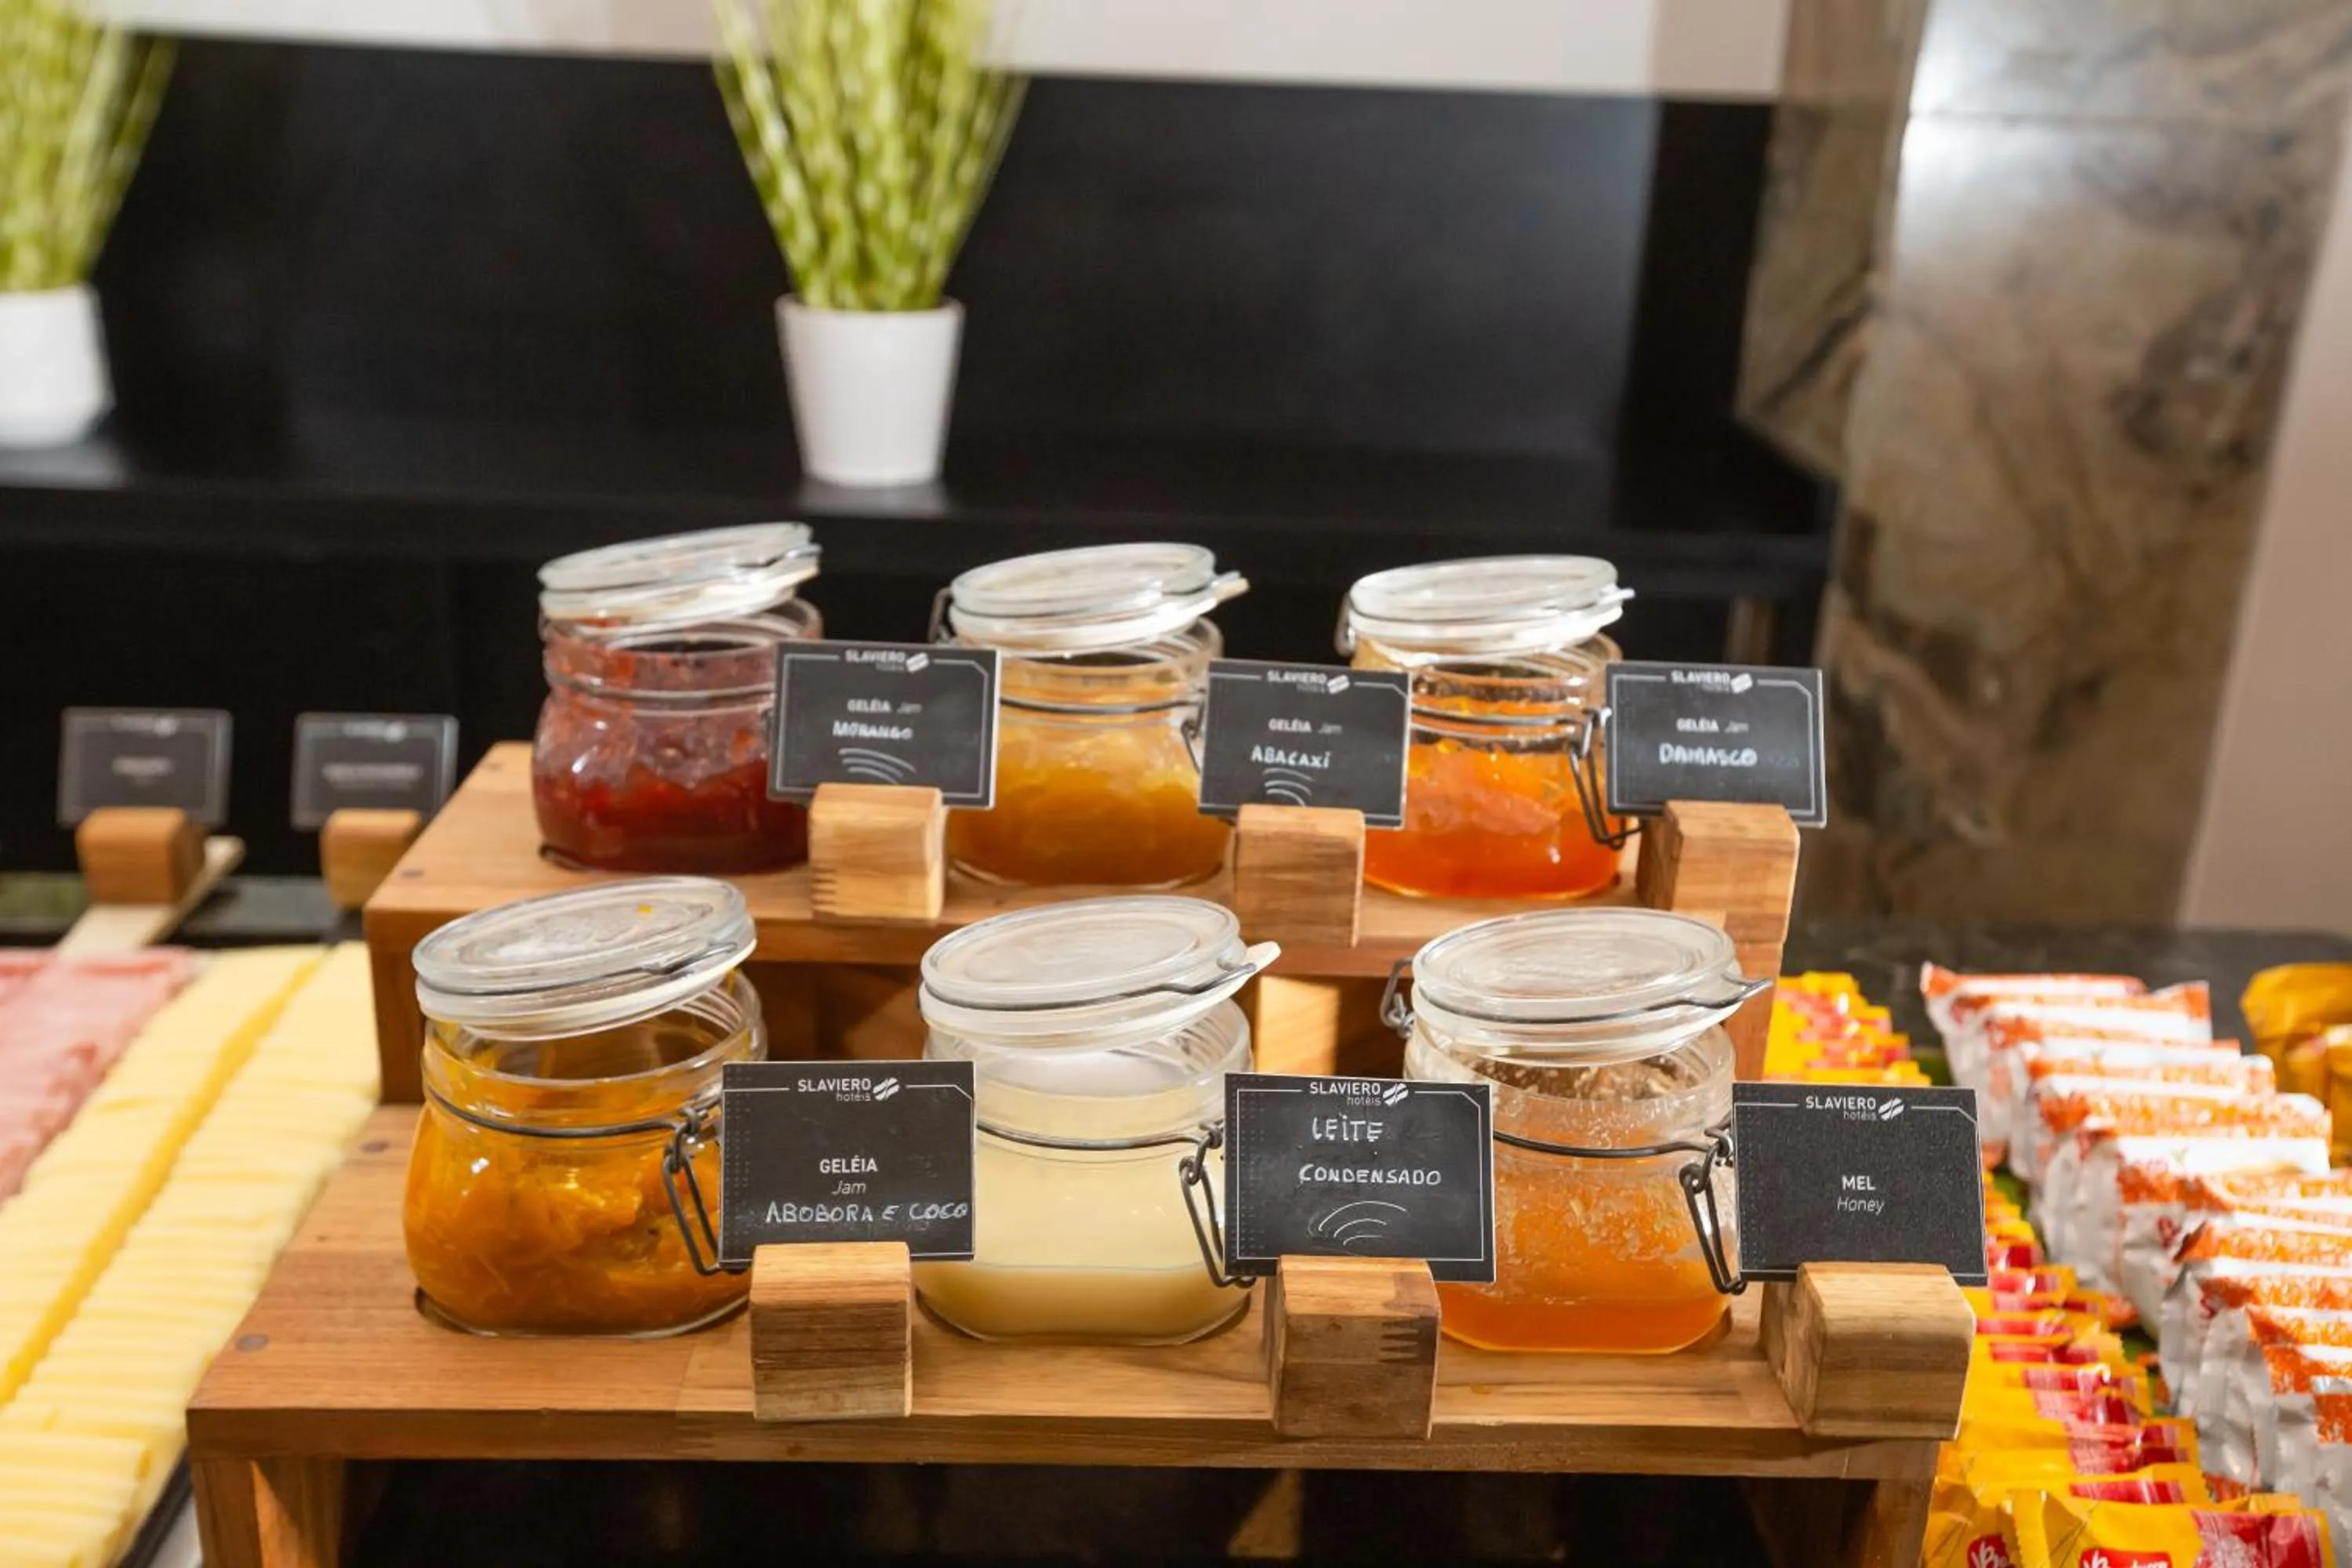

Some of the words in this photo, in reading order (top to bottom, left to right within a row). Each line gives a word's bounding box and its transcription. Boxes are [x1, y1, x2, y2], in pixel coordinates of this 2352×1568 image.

[845, 649, 906, 663] SLAVIERO
[1267, 670, 1328, 684] SLAVIERO
[1671, 670, 1731, 684] SLAVIERO
[832, 720, 913, 740] MORANGO
[1658, 742, 1758, 767] DAMASCO
[797, 1078, 872, 1092] SLAVIERO
[1309, 1081, 1381, 1095] SLAVIERO
[1806, 1096, 1876, 1110] SLAVIERO
[819, 1155, 878, 1174] GELÉIA
[1298, 1163, 1442, 1185] CONDENSADO
[1842, 1175, 1876, 1191] MEL
[765, 1200, 874, 1223] ABOBORA
[882, 1205, 900, 1221] E
[909, 1202, 968, 1220] COCO
[1837, 1196, 1885, 1214] Honey
